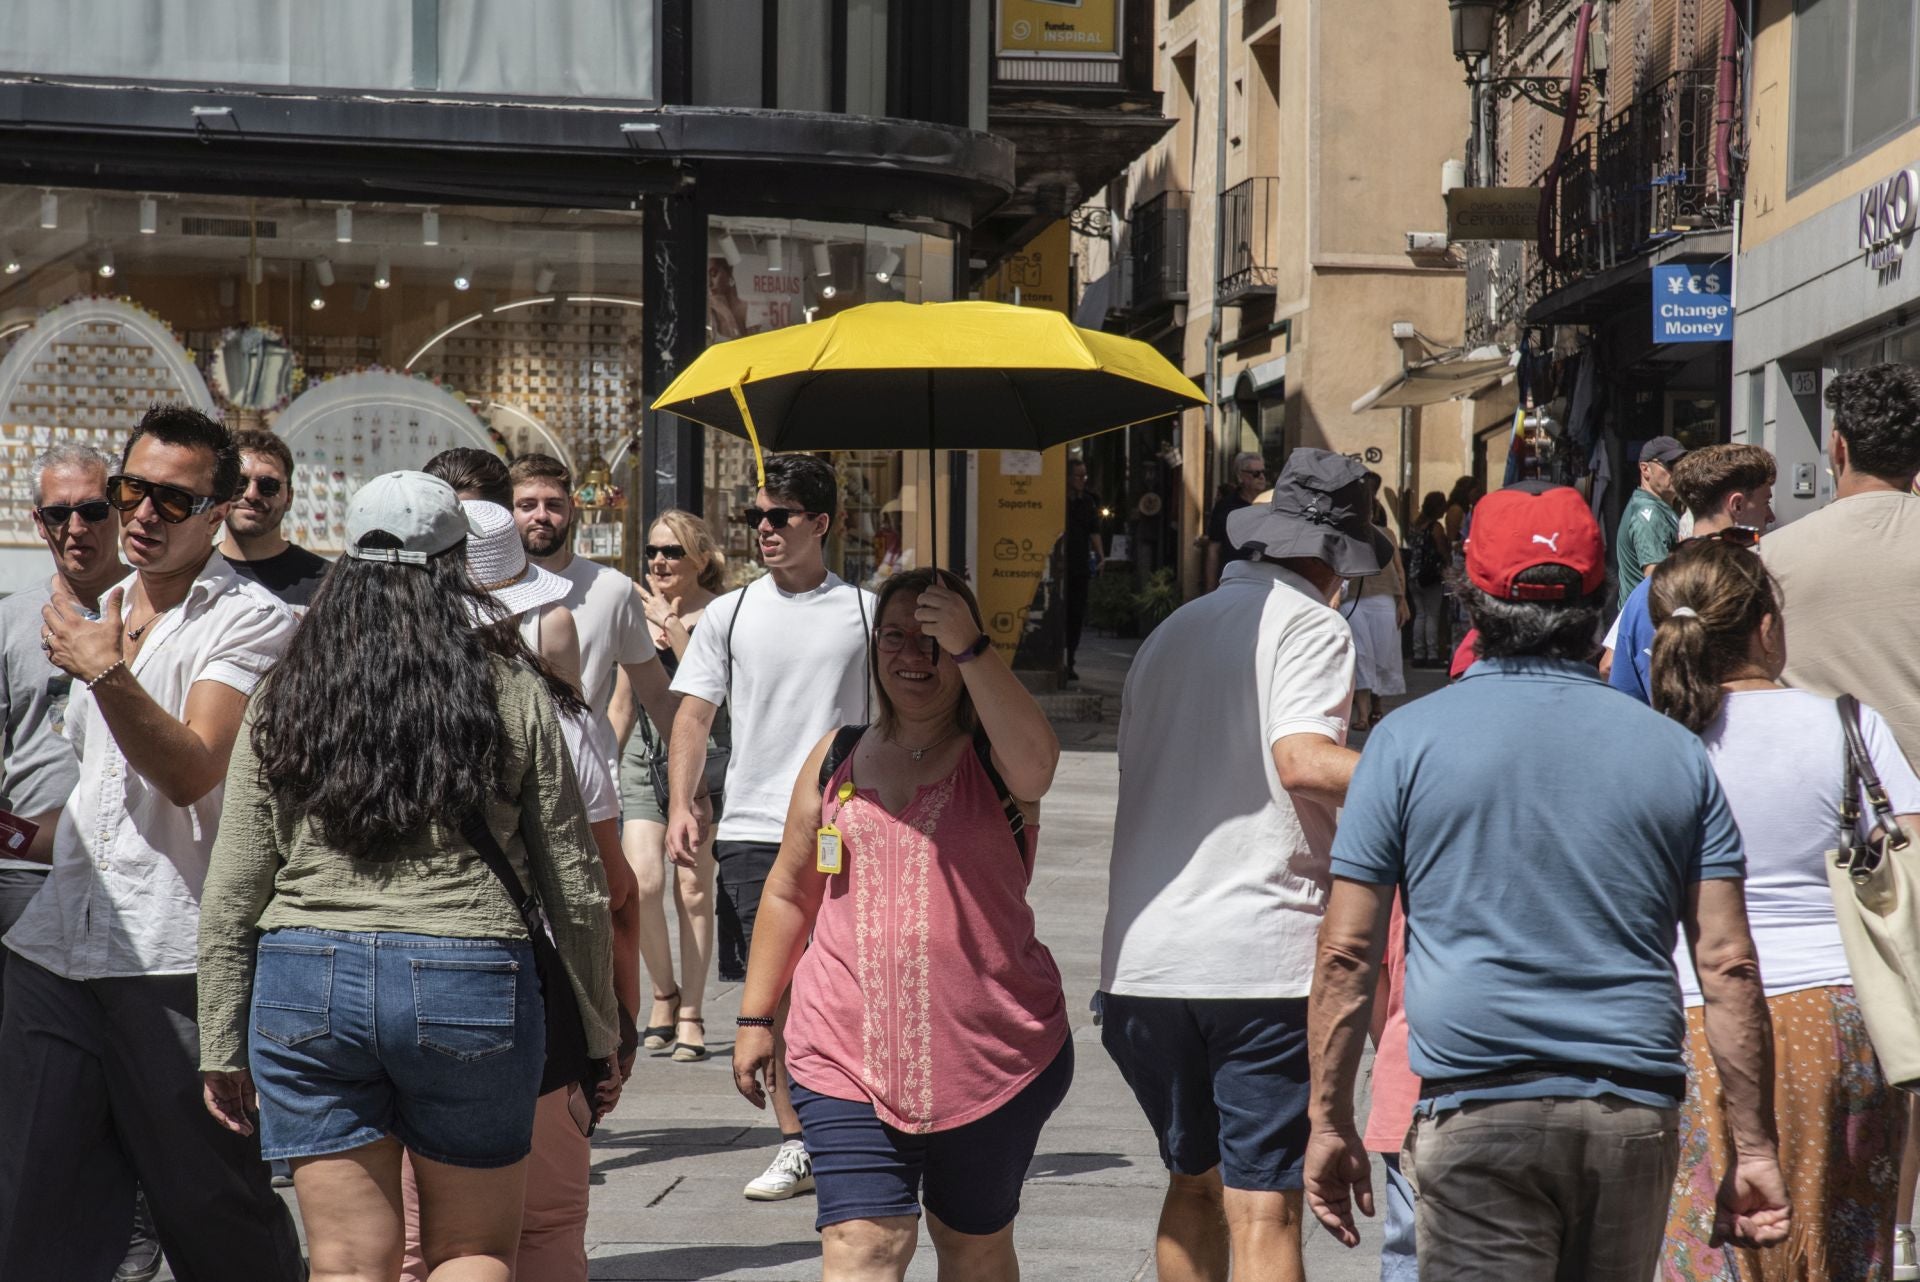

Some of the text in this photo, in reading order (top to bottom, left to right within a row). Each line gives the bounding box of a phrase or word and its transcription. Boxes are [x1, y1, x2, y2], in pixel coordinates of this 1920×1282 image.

[1044, 21, 1075, 31] fundas
[1044, 31, 1103, 43] INSPIRAL
[1859, 169, 1916, 249] KIKO
[753, 274, 801, 295] REBAJAS
[1660, 304, 1728, 319] Change
[1665, 321, 1724, 337] Money
[998, 498, 1043, 510] Soportes
